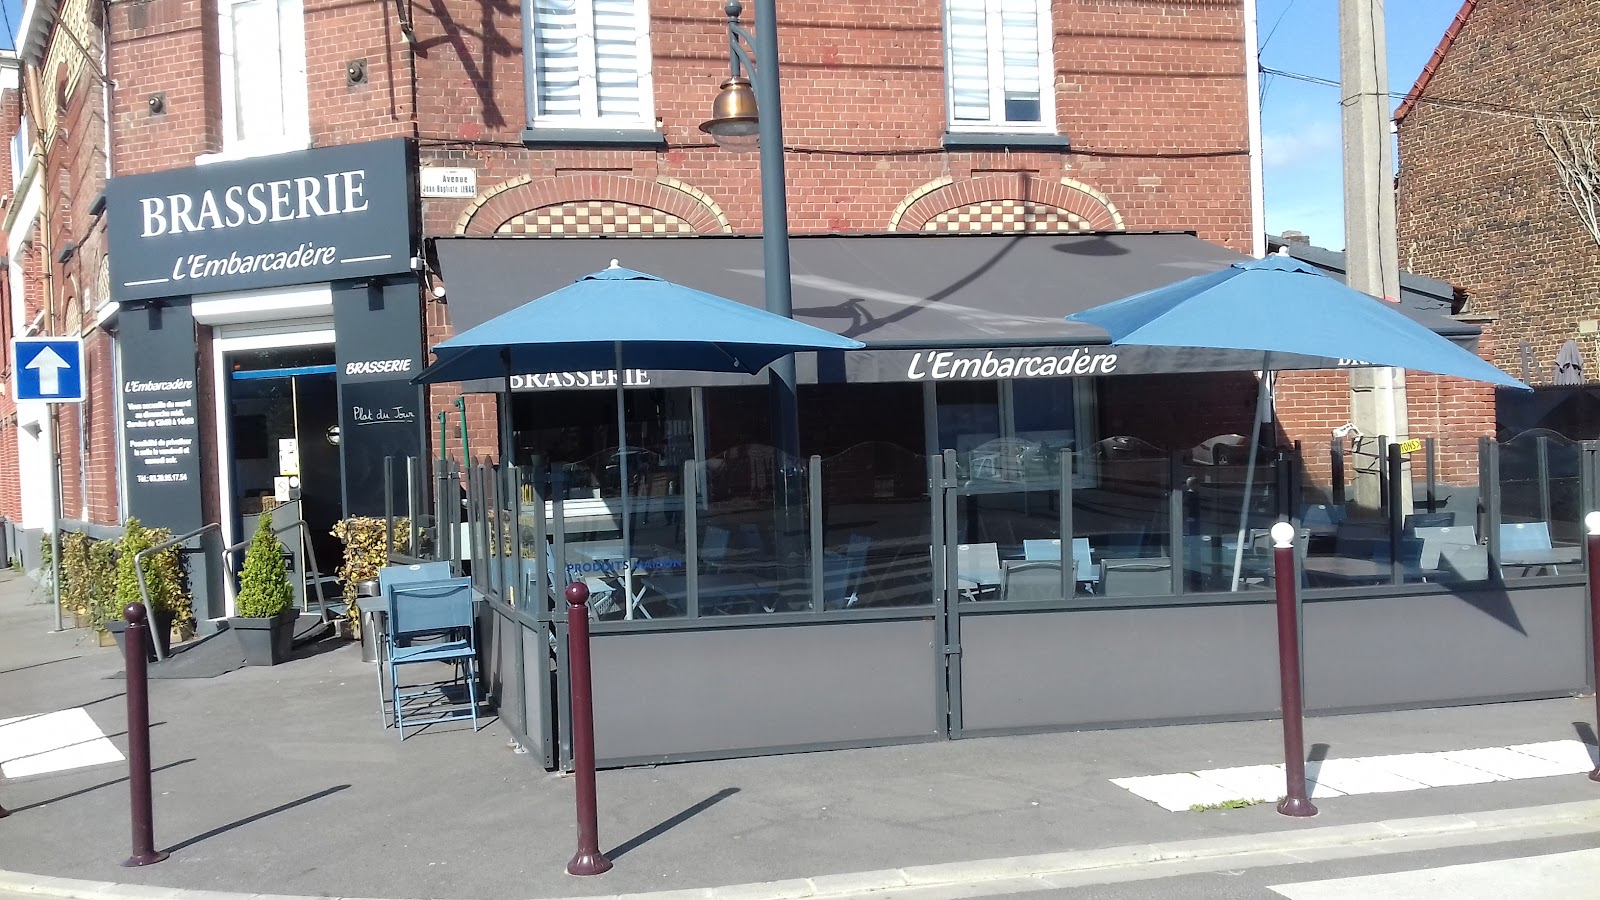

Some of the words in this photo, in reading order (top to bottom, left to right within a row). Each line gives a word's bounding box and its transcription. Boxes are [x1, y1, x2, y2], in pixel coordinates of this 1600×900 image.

[442, 175, 468, 183] Avenue
[460, 185, 475, 193] LEBAS
[139, 169, 369, 238] BRASSERIE
[172, 241, 337, 281] L'Embarcadère
[345, 358, 412, 375] BRASSERIE
[907, 347, 1118, 380] L'Embarcadère
[124, 378, 193, 392] L'Embarcadère
[127, 402, 142, 410] Vous
[175, 399, 192, 408] mardi
[143, 410, 170, 418] dimanche
[353, 406, 374, 421] Plat
[376, 408, 391, 420] du
[392, 406, 415, 419] Jour
[126, 420, 146, 428] Service
[159, 446, 183, 455] vendredi
[566, 561, 629, 573] PRODUITS
